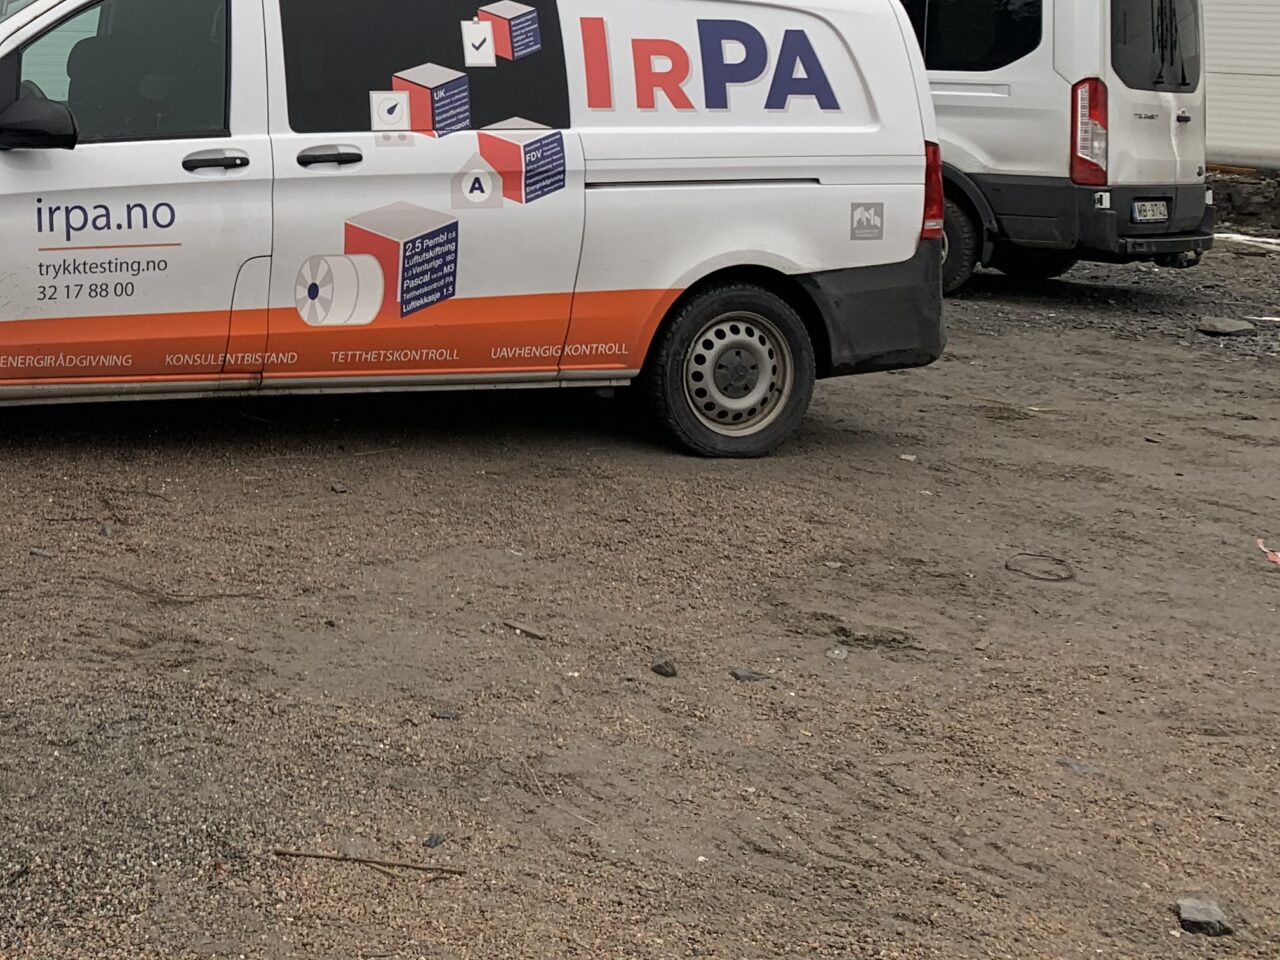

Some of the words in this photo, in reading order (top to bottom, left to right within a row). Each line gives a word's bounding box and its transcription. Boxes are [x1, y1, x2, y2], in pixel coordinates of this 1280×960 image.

[580, 17, 842, 111] IRPA
[434, 89, 446, 100] UK
[526, 149, 542, 163] FDV
[468, 177, 486, 194] A
[36, 198, 176, 241] irpa.no
[405, 239, 421, 256] 2.5
[38, 257, 168, 280] trykktesting.no
[403, 271, 430, 290] Pascal
[36, 284, 58, 301] 32
[64, 283, 84, 300] 17
[88, 282, 109, 299] 88
[113, 281, 135, 298] 00
[165, 352, 298, 366] KONSULENTBISTAND
[330, 348, 460, 363] TETTHETSKONTROLL
[491, 344, 561, 359] UAVHENGIG
[563, 343, 629, 356] KONTROLL
[0, 353, 132, 368] ENERGIRÅDGIVNING
